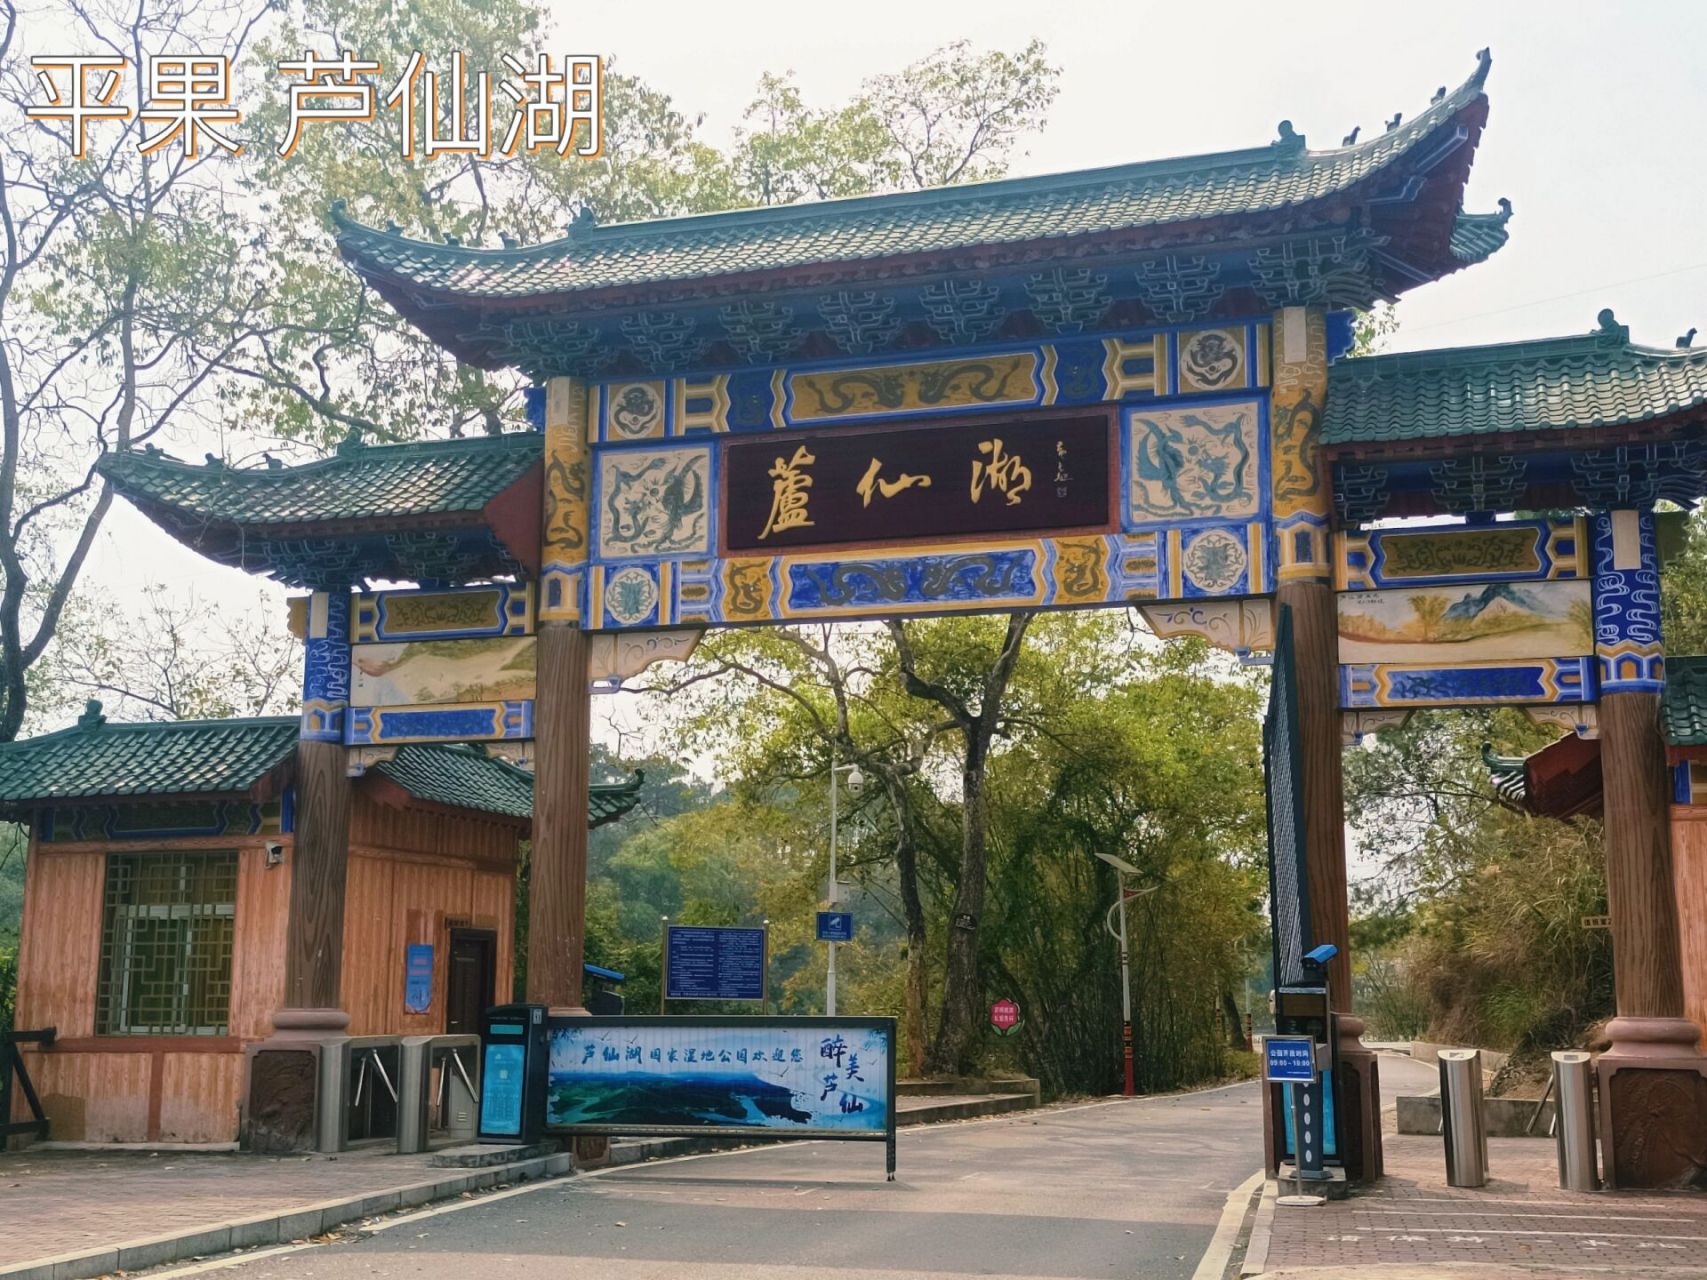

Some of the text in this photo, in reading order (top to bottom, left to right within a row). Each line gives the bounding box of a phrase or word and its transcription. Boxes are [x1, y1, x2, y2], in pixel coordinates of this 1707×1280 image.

[581, 1044, 804, 1065] 芦仙湖国家湿地公园欢迎您
